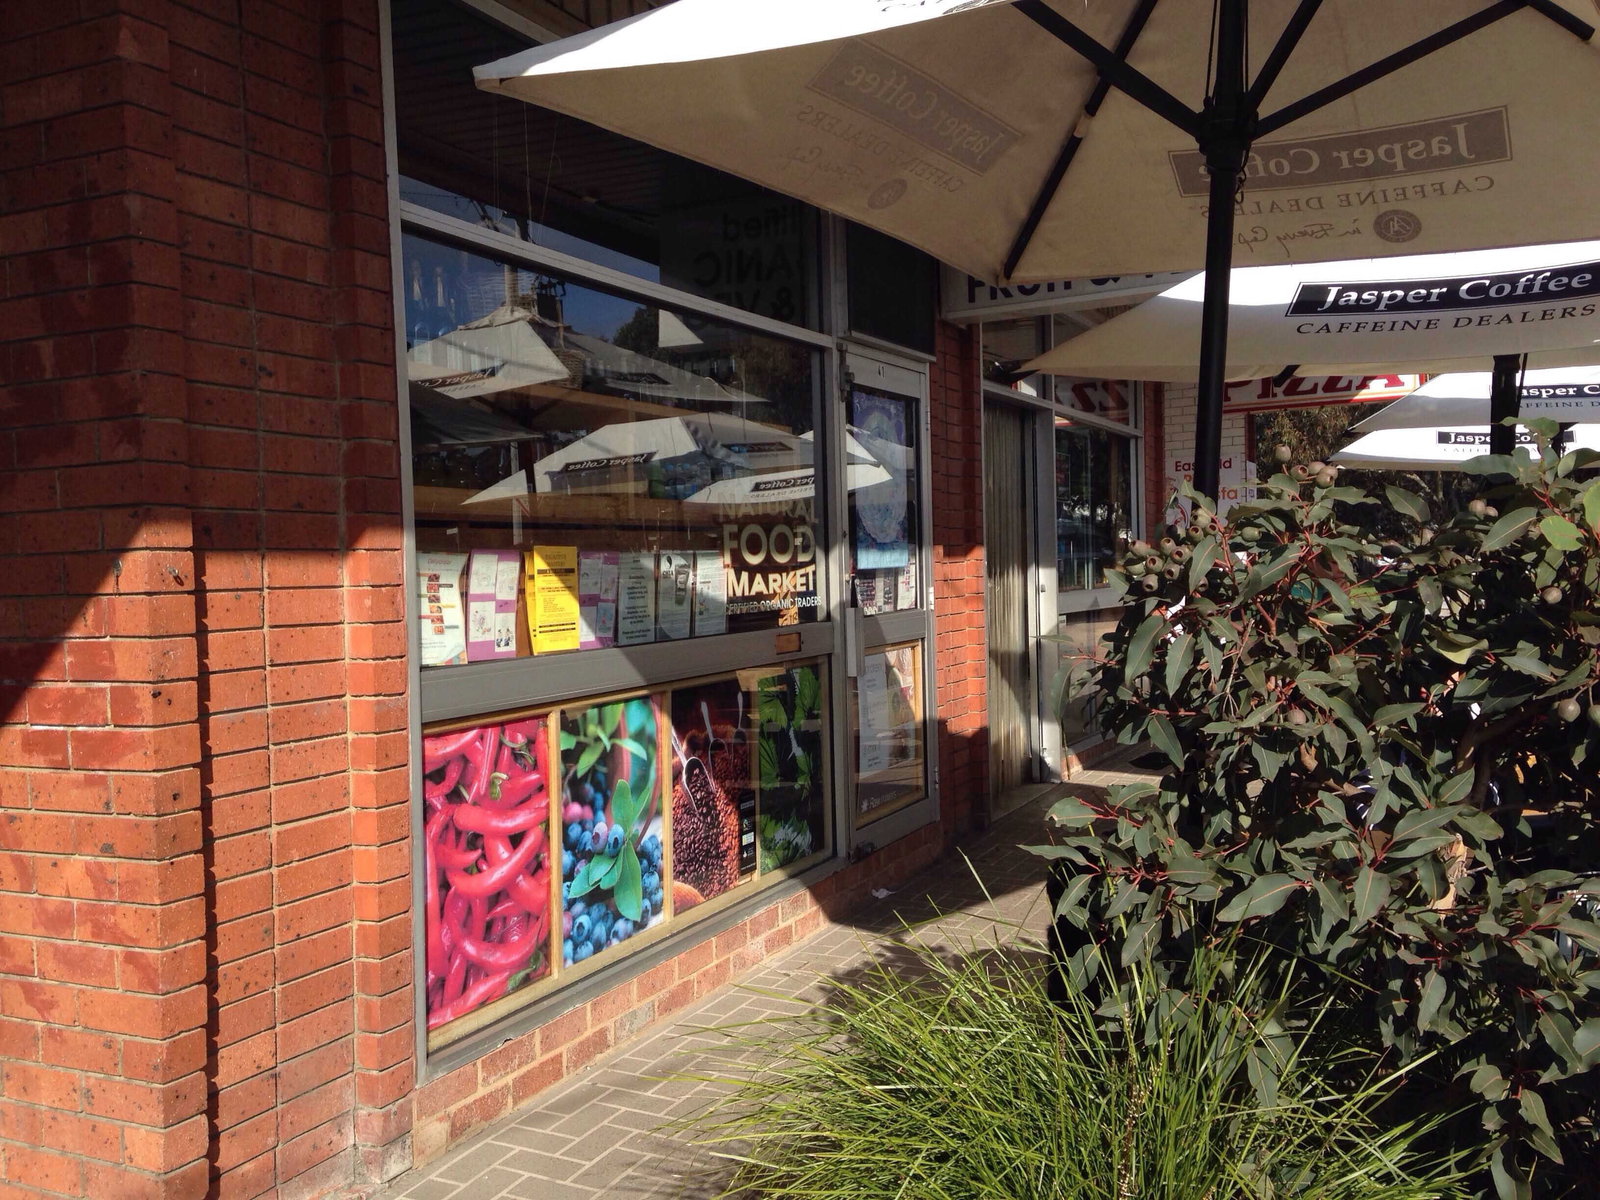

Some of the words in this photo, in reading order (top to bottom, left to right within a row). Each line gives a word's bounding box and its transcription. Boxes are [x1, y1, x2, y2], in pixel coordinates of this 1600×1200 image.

[1317, 286, 1447, 311] Jasper
[1459, 271, 1593, 300] Coffee
[1296, 318, 1440, 335] CAFFEINE
[1452, 303, 1597, 329] DEALERS
[1520, 386, 1578, 397] asper
[1449, 432, 1491, 445] Jaspe
[723, 523, 816, 566] FOOD
[726, 563, 816, 598] MARKET
[760, 597, 795, 612] ORGANIC
[794, 596, 822, 608] TRADERS
